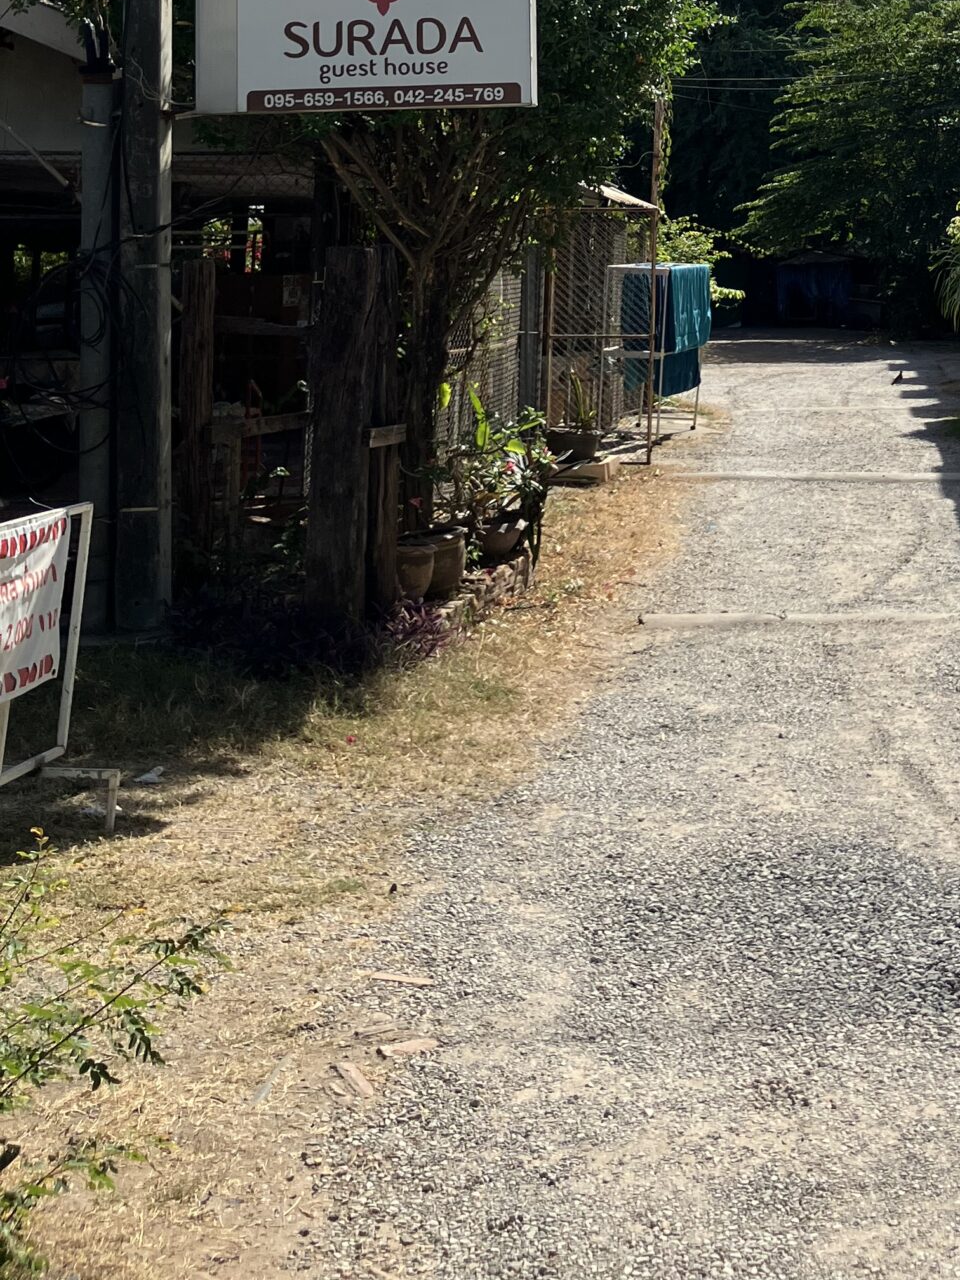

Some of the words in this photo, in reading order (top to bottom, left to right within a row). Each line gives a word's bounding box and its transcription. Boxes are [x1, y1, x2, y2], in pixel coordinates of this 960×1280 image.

[283, 16, 484, 58] SURADA
[319, 59, 378, 84] guest
[384, 57, 449, 76] house
[264, 90, 390, 108] 095-659-1566,
[393, 87, 505, 105] 042-245-769
